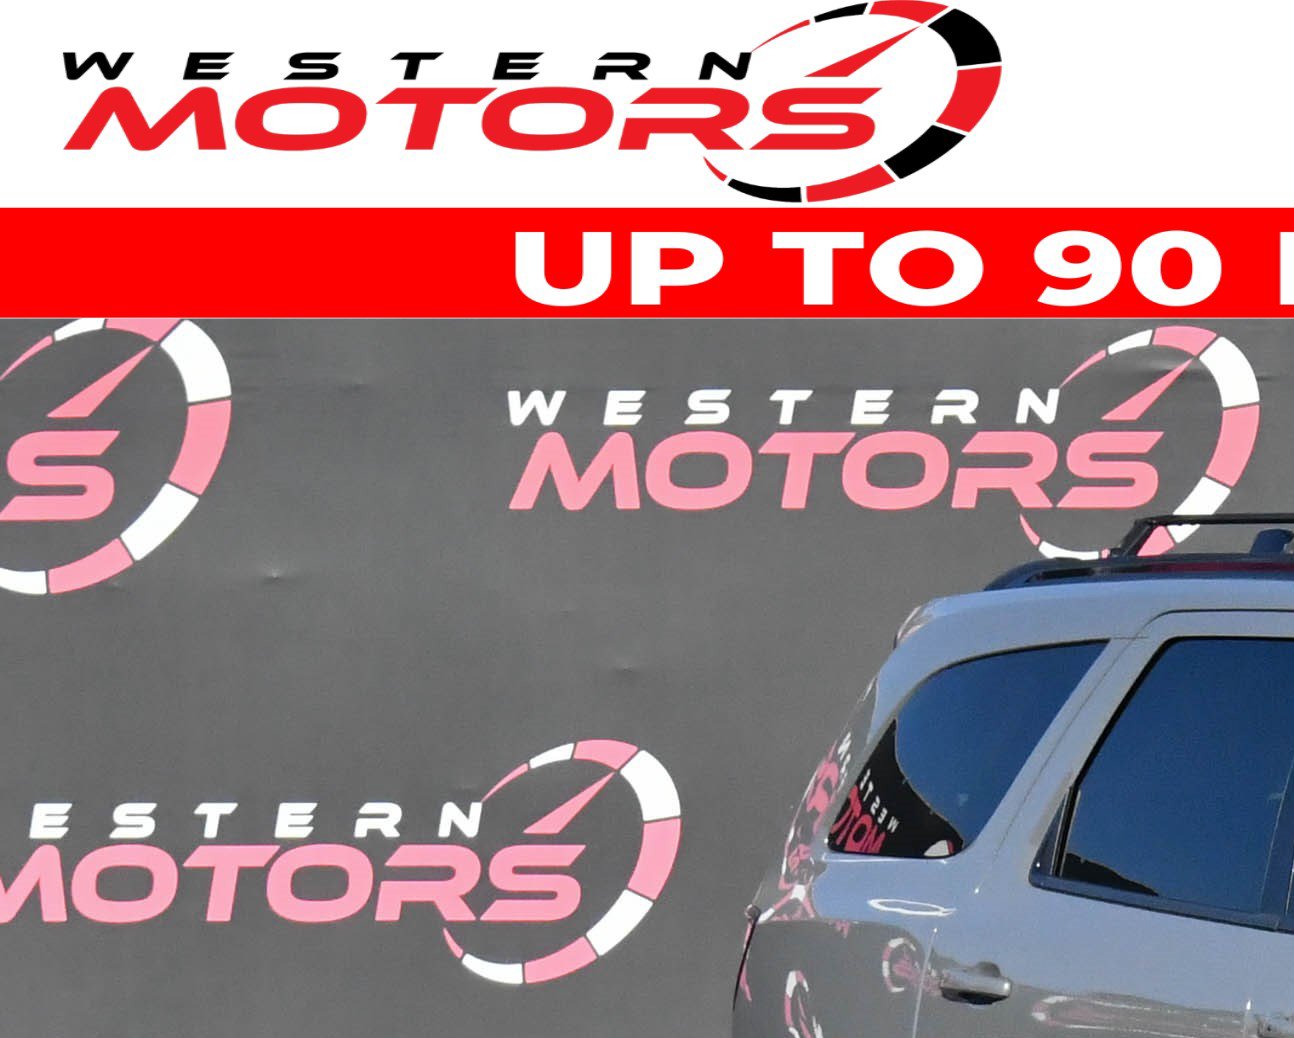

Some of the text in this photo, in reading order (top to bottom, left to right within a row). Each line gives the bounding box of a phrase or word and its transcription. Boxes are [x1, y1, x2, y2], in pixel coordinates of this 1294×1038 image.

[507, 387, 1060, 426] WESTERN
[509, 430, 1165, 512] MOTORS
[29, 801, 483, 839] ESTERN
